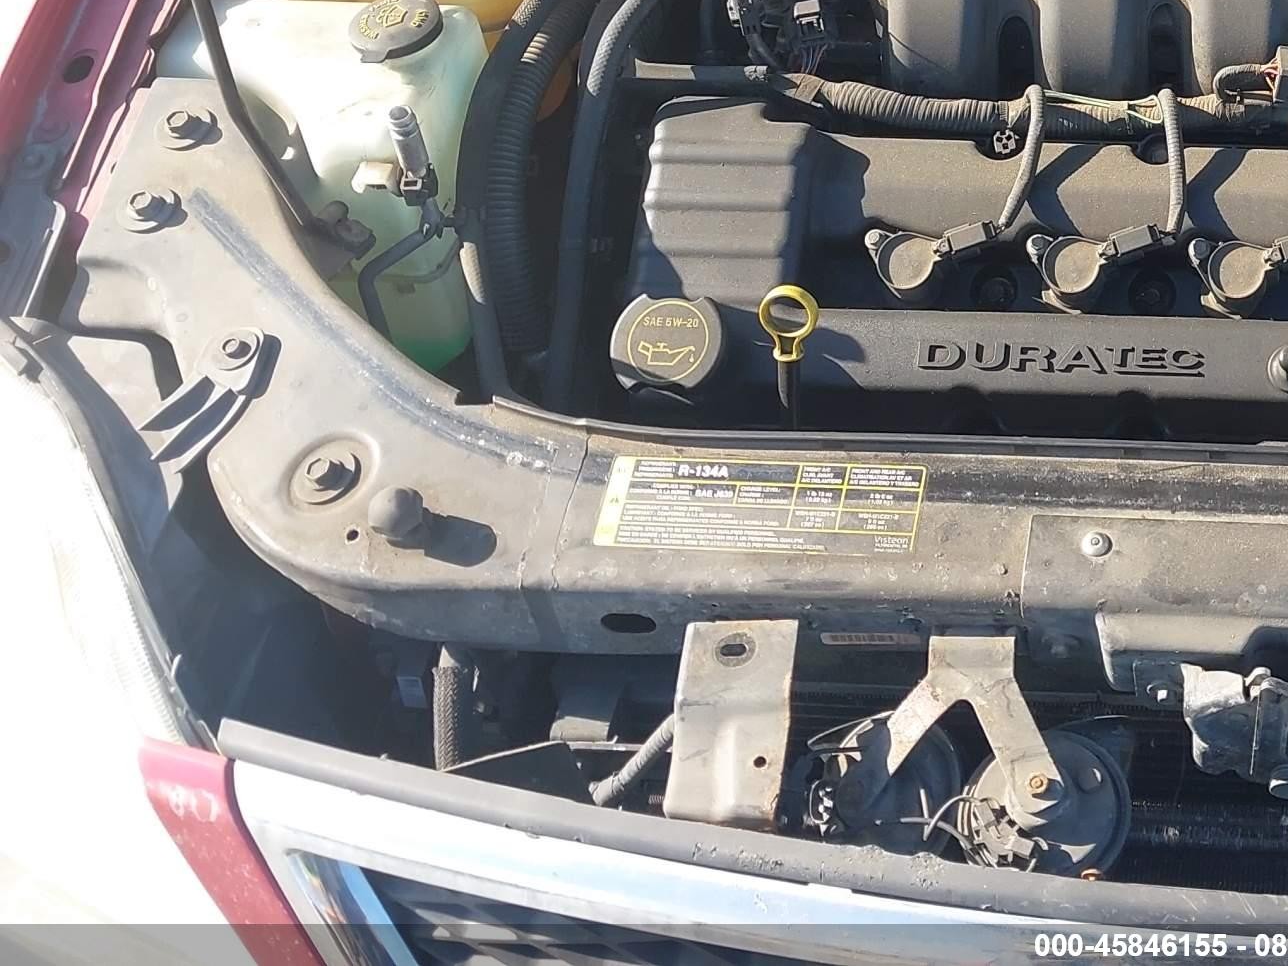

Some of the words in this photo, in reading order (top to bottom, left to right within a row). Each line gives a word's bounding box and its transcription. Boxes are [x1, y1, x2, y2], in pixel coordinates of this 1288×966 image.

[643, 316, 663, 327] SAE
[917, 340, 1206, 375] DURATEC
[678, 464, 728, 478] R-134A
